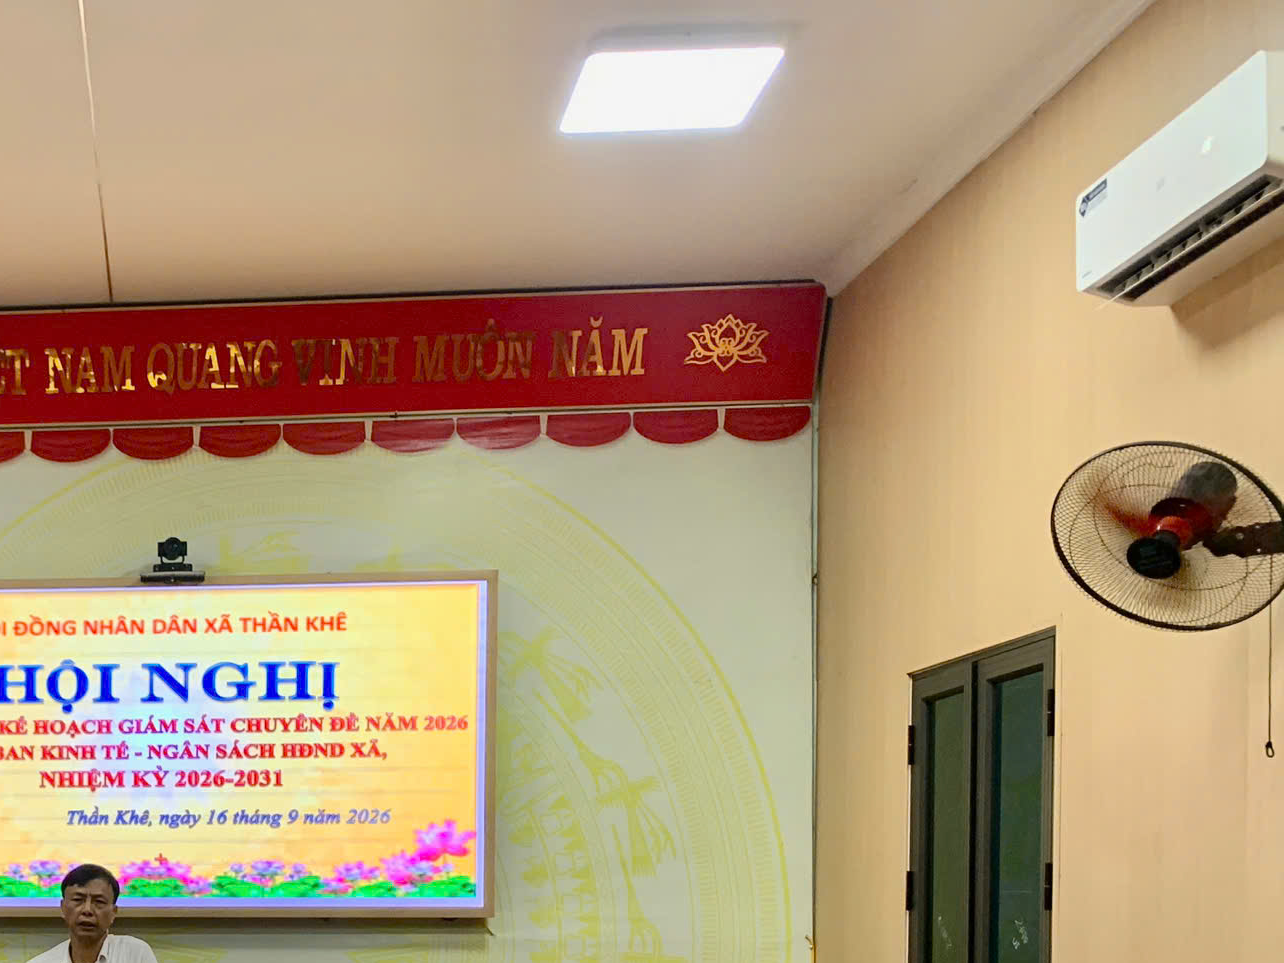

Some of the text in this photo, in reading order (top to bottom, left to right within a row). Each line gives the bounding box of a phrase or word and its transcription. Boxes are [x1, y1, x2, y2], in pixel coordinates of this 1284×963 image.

[45, 345, 135, 395] NAM
[147, 338, 283, 395] QUANG
[291, 336, 400, 386] VINH
[412, 318, 535, 384] MUÔN
[548, 316, 649, 378] NĂM
[13, 614, 77, 636] ĐỒNG
[83, 616, 146, 635] NHÂN
[153, 615, 197, 634] DÂN
[204, 614, 234, 633] XÃ
[239, 611, 299, 633] THẦN
[306, 612, 348, 632] KHÊ
[140, 661, 340, 712] NGHỊ
[33, 719, 113, 739] HOẠCH
[118, 715, 178, 735] GIÁM
[183, 714, 225, 734] SÁT
[230, 713, 324, 733] CHUYÊN
[365, 712, 418, 732] NĂM
[424, 715, 469, 731] 2026
[40, 745, 97, 760] KINH
[147, 740, 210, 760] NGÂN
[216, 739, 275, 759] SÁCH
[281, 742, 345, 759] HĐND
[350, 739, 388, 760] XÃ,
[39, 765, 283, 792] NHIỆM KỲ 2026-2031
[66, 806, 392, 829] Thần Khê, ngày 16 tháng 9 năm 2026
